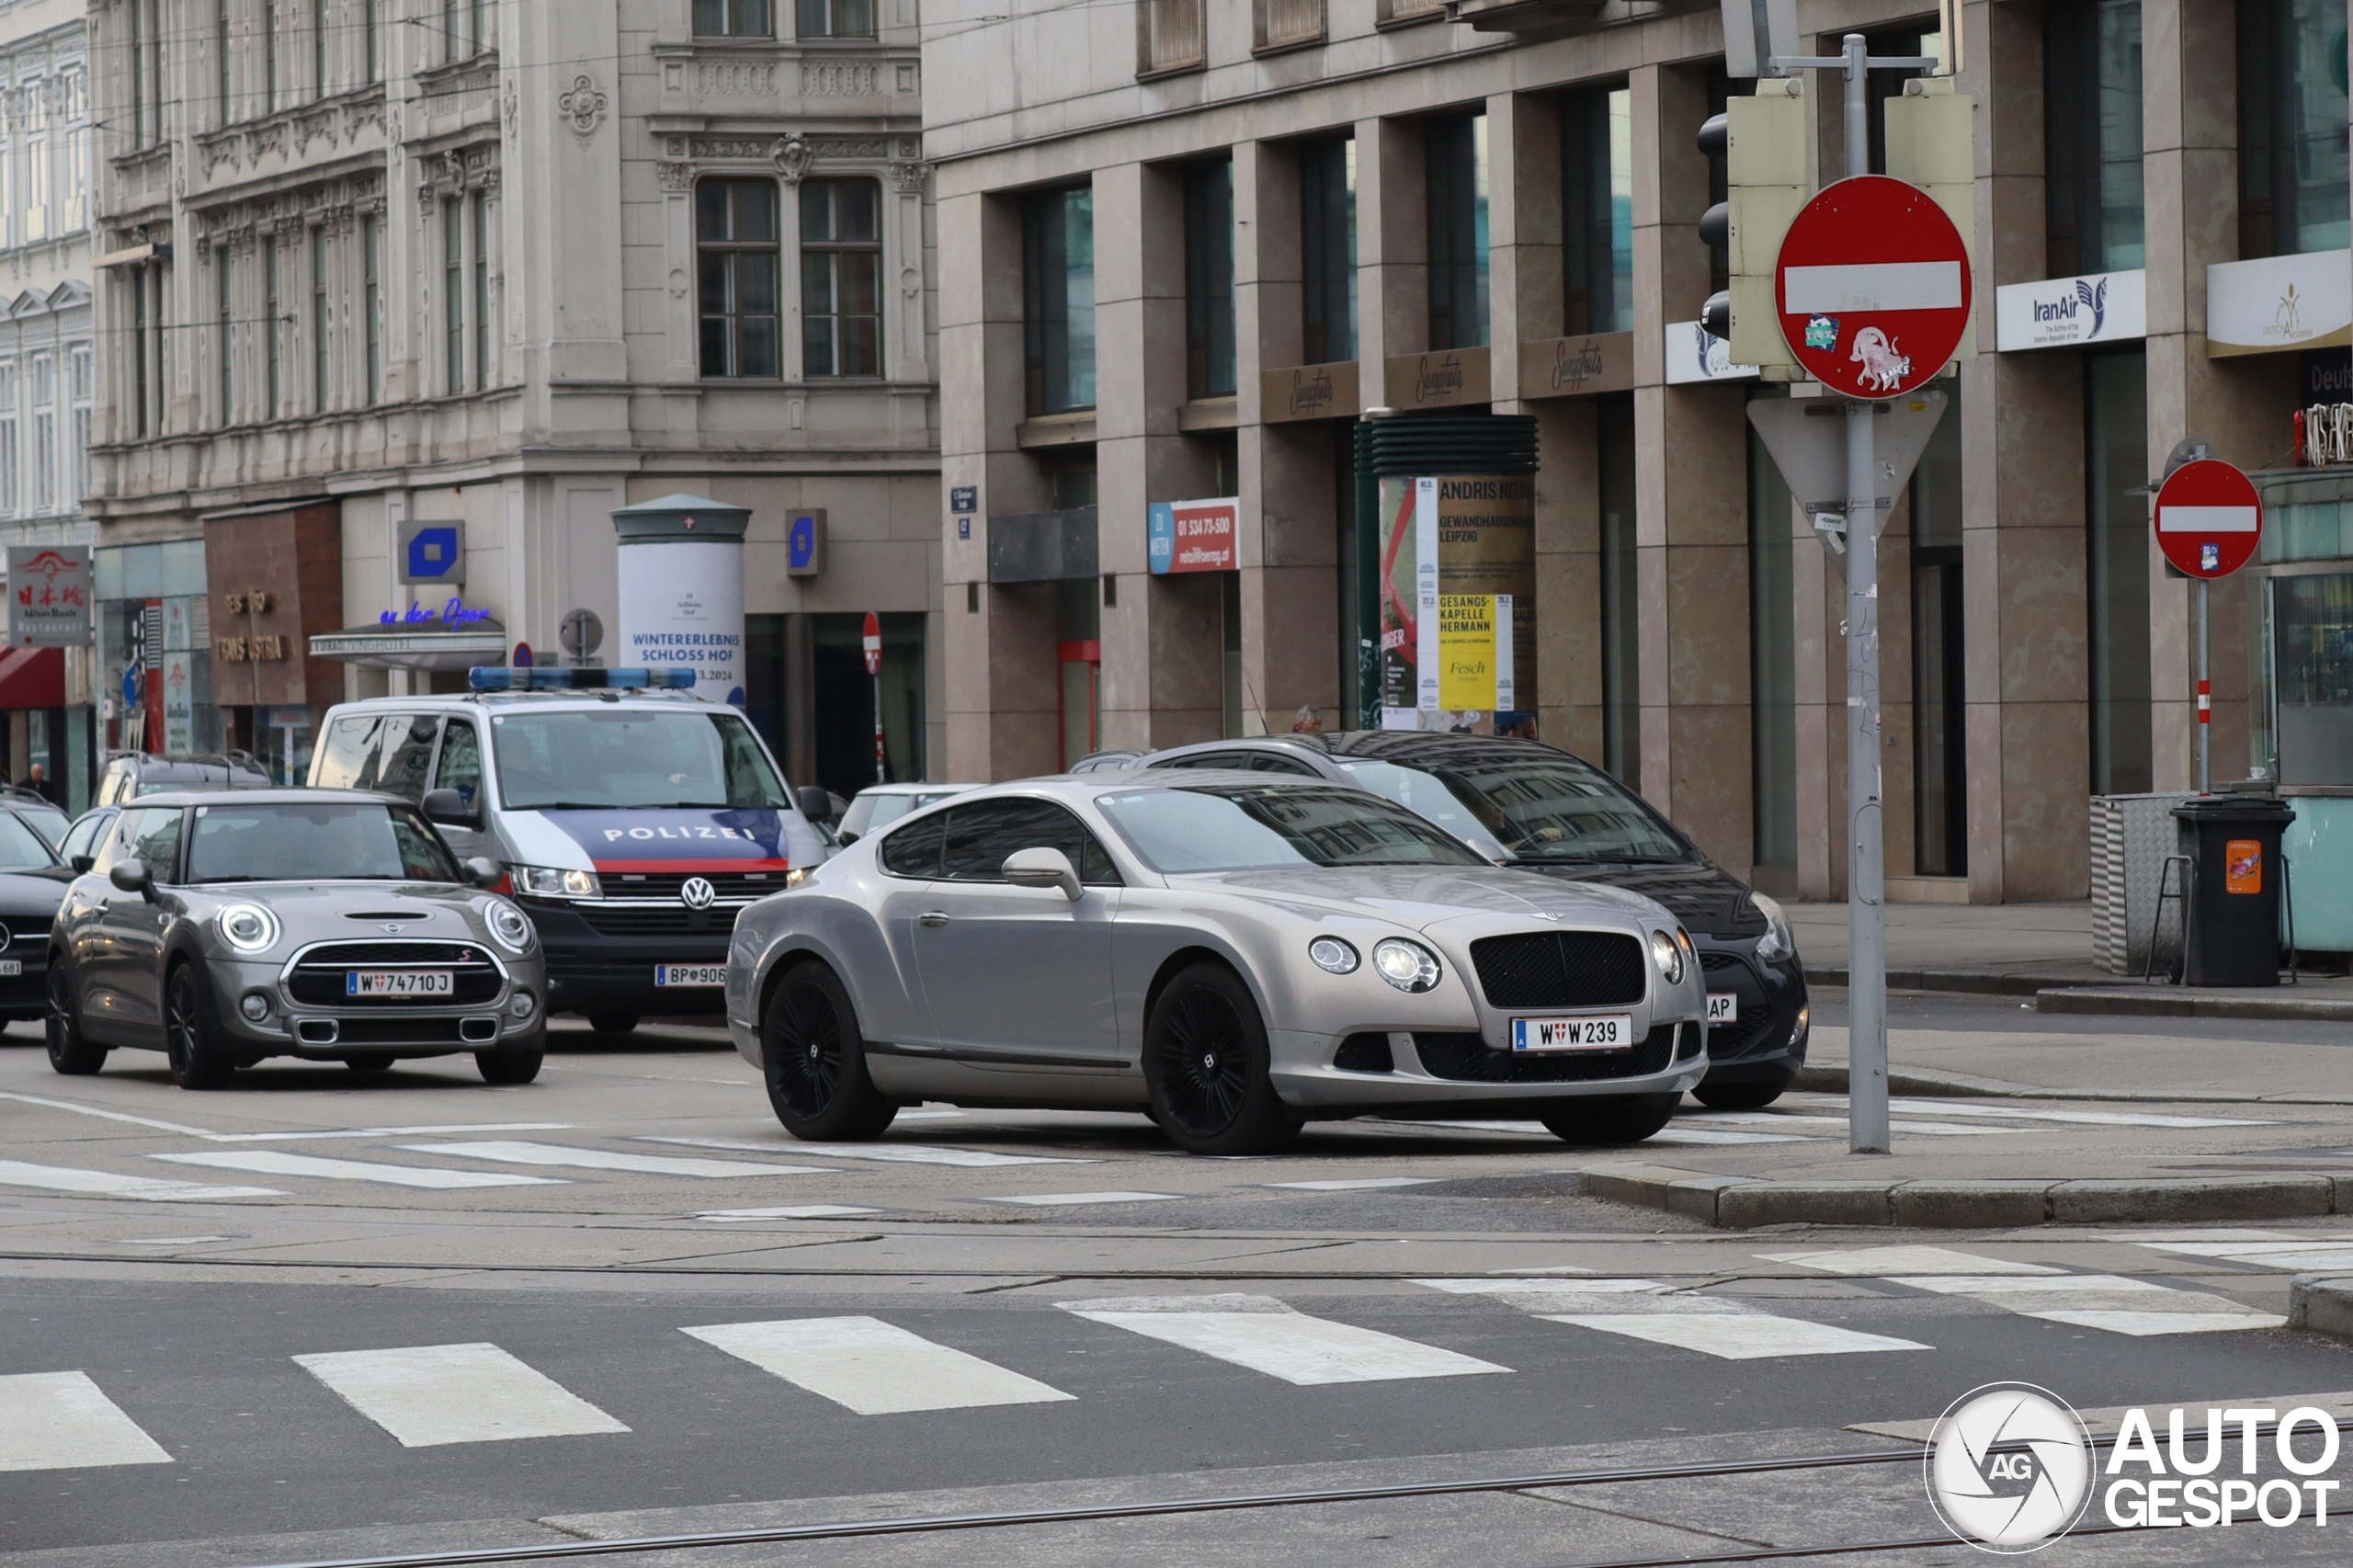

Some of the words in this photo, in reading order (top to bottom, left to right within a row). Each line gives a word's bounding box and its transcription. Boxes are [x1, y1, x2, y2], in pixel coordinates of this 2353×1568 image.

[2034, 294, 2078, 322] IranAir
[1440, 482, 1495, 499] ANDRIS
[1177, 520, 1187, 536] 01
[1188, 519, 1202, 535] 534
[1204, 517, 1230, 534] 73-500
[1440, 530, 1477, 542] LEIPZIG
[1151, 537, 1169, 555] MIETEN
[1440, 597, 1489, 607] GESANGS-
[404, 601, 435, 622] der
[442, 597, 490, 632] Oper
[1440, 609, 1484, 619] KAPELLE
[1440, 621, 1490, 632] HERMANN
[633, 634, 739, 645] WINTERERLEBNIS
[642, 650, 704, 661] SCHLOSS
[709, 650, 733, 661] HOF
[1450, 662, 1484, 674] Fesch
[604, 827, 756, 842] POLIZEI
[361, 975, 372, 991] W
[387, 975, 435, 991] 74710
[439, 975, 448, 991] J
[671, 968, 688, 983] BP
[699, 968, 726, 983] 906
[1709, 999, 1730, 1017] AP
[1540, 1024, 1553, 1044] W
[1569, 1023, 1581, 1043] W
[1586, 1022, 1617, 1042] 239
